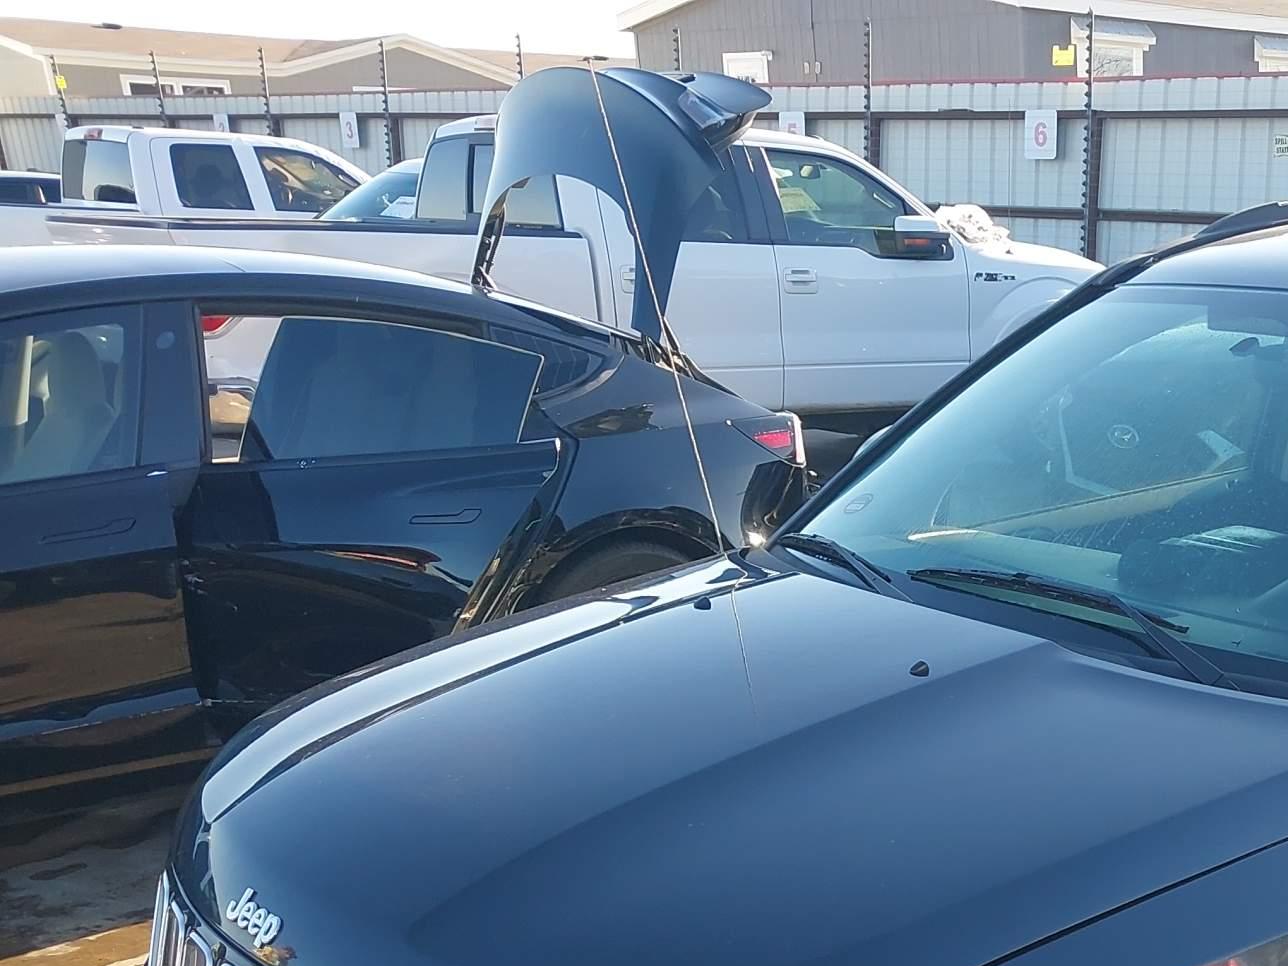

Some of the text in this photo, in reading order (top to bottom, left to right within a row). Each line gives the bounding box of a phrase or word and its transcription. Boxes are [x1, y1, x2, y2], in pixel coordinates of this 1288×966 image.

[345, 121, 354, 139] 3
[1034, 121, 1048, 147] 6
[226, 887, 282, 949] Jeep
